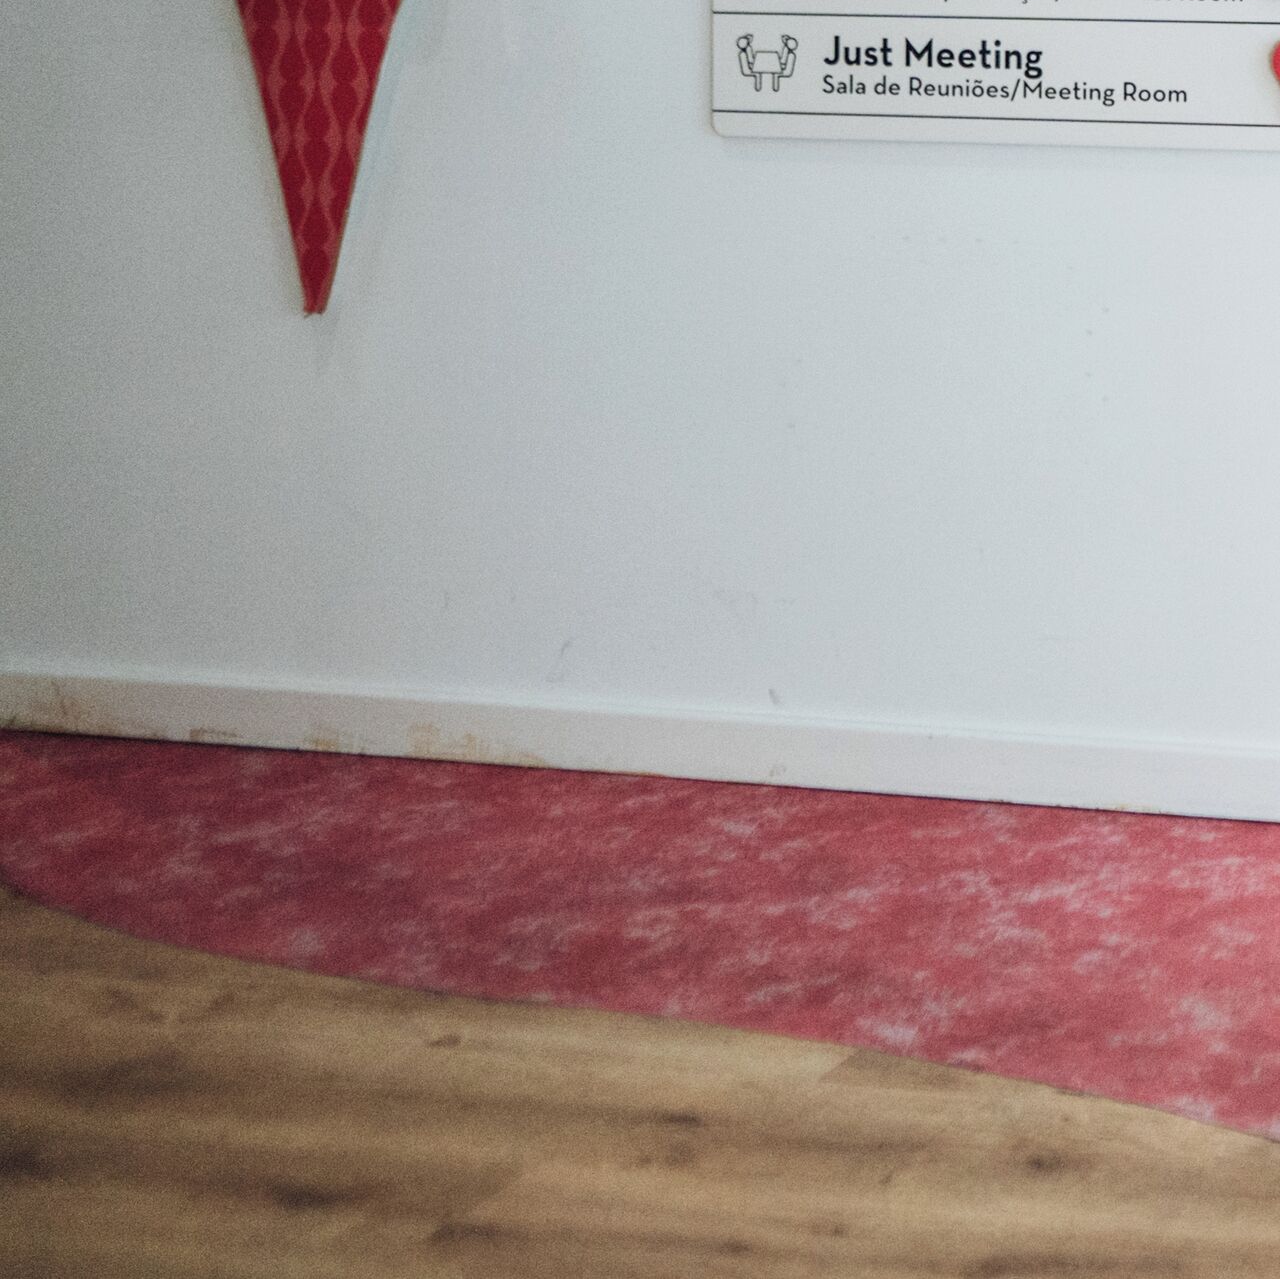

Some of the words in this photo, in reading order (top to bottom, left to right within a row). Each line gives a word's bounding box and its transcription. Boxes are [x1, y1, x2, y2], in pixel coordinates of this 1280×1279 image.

[823, 34, 894, 68] Just
[904, 37, 1044, 84] Meeting
[822, 73, 867, 95] Sala
[873, 74, 901, 96] de
[908, 76, 1116, 108] Reuniões/Meeting
[1123, 81, 1188, 103] Room
